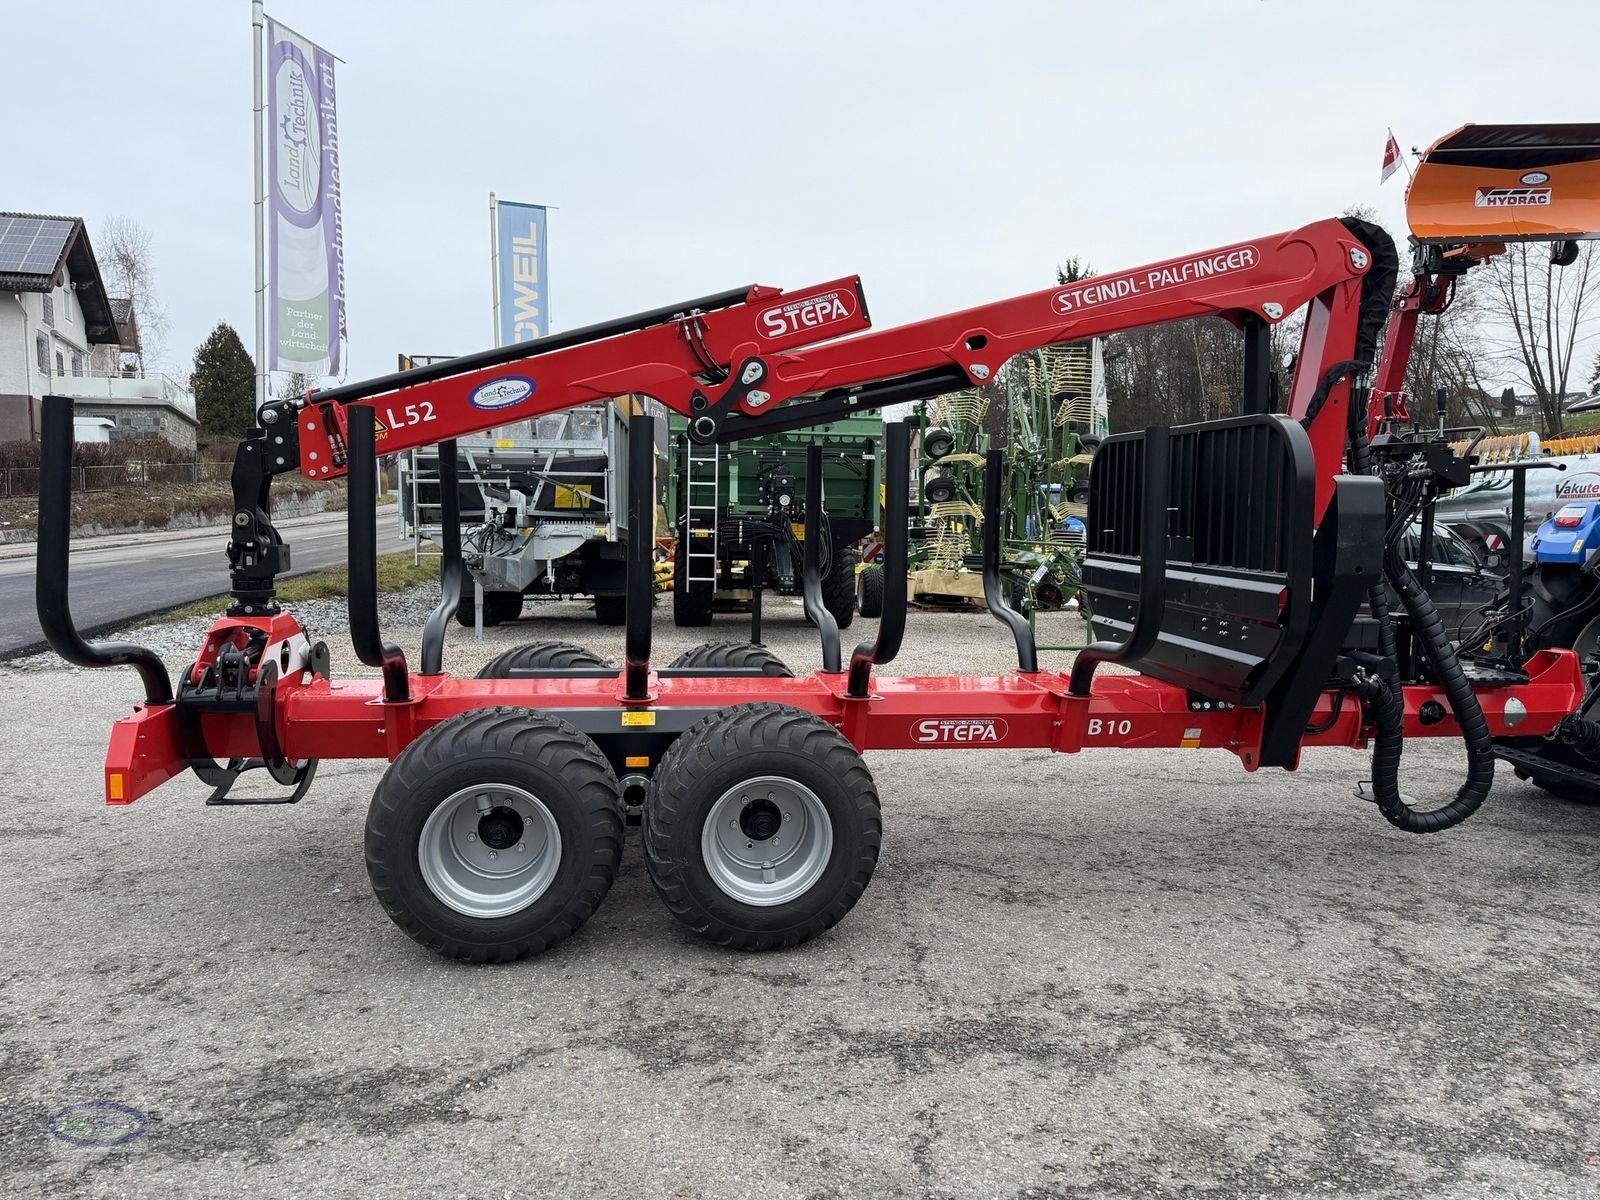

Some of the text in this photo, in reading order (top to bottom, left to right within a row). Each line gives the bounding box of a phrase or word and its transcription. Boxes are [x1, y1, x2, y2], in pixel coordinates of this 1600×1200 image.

[284, 72, 307, 190] Land Technik
[1487, 195, 1547, 206] HYDRAC
[1057, 249, 1255, 312] STEINDL-PALFINGER
[287, 307, 323, 321] Partner
[763, 298, 850, 338] STEPA
[297, 319, 315, 329] der
[291, 328, 320, 340] Land-
[918, 720, 998, 742] STEPA
[1087, 718, 1132, 736] B 10
